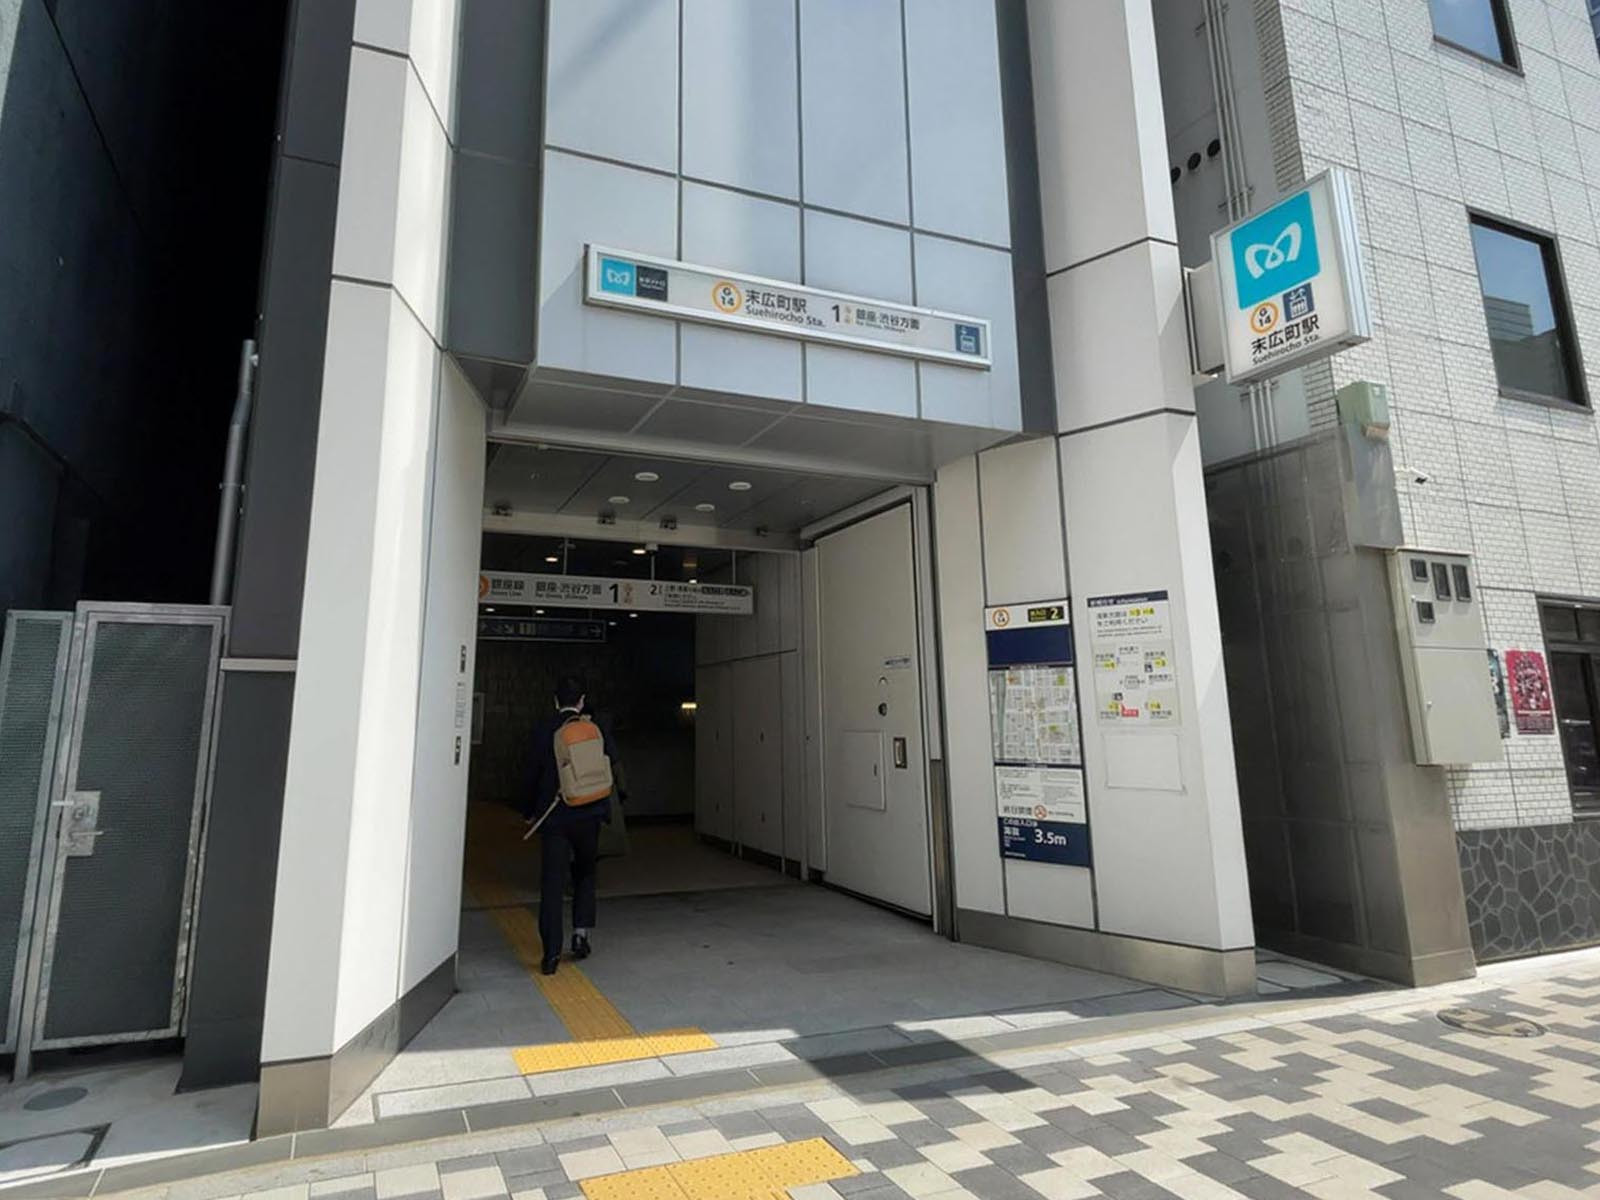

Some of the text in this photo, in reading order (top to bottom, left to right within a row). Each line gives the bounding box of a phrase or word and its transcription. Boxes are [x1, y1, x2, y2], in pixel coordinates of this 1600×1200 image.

[722, 286, 733, 298] G
[721, 295, 736, 308] 14
[745, 289, 808, 315] 末広町駅
[745, 305, 827, 328] Suehirocho Sta.
[830, 304, 841, 323] 1
[1259, 307, 1268, 317] G
[1259, 314, 1272, 328] 14
[1251, 314, 1320, 356] 末広町駅
[1252, 334, 1321, 365] Suehirocho Sta.
[608, 583, 619, 604] 1
[649, 584, 658, 596] 2
[1049, 606, 1060, 620] 2
[1033, 828, 1068, 846] 3.5m
